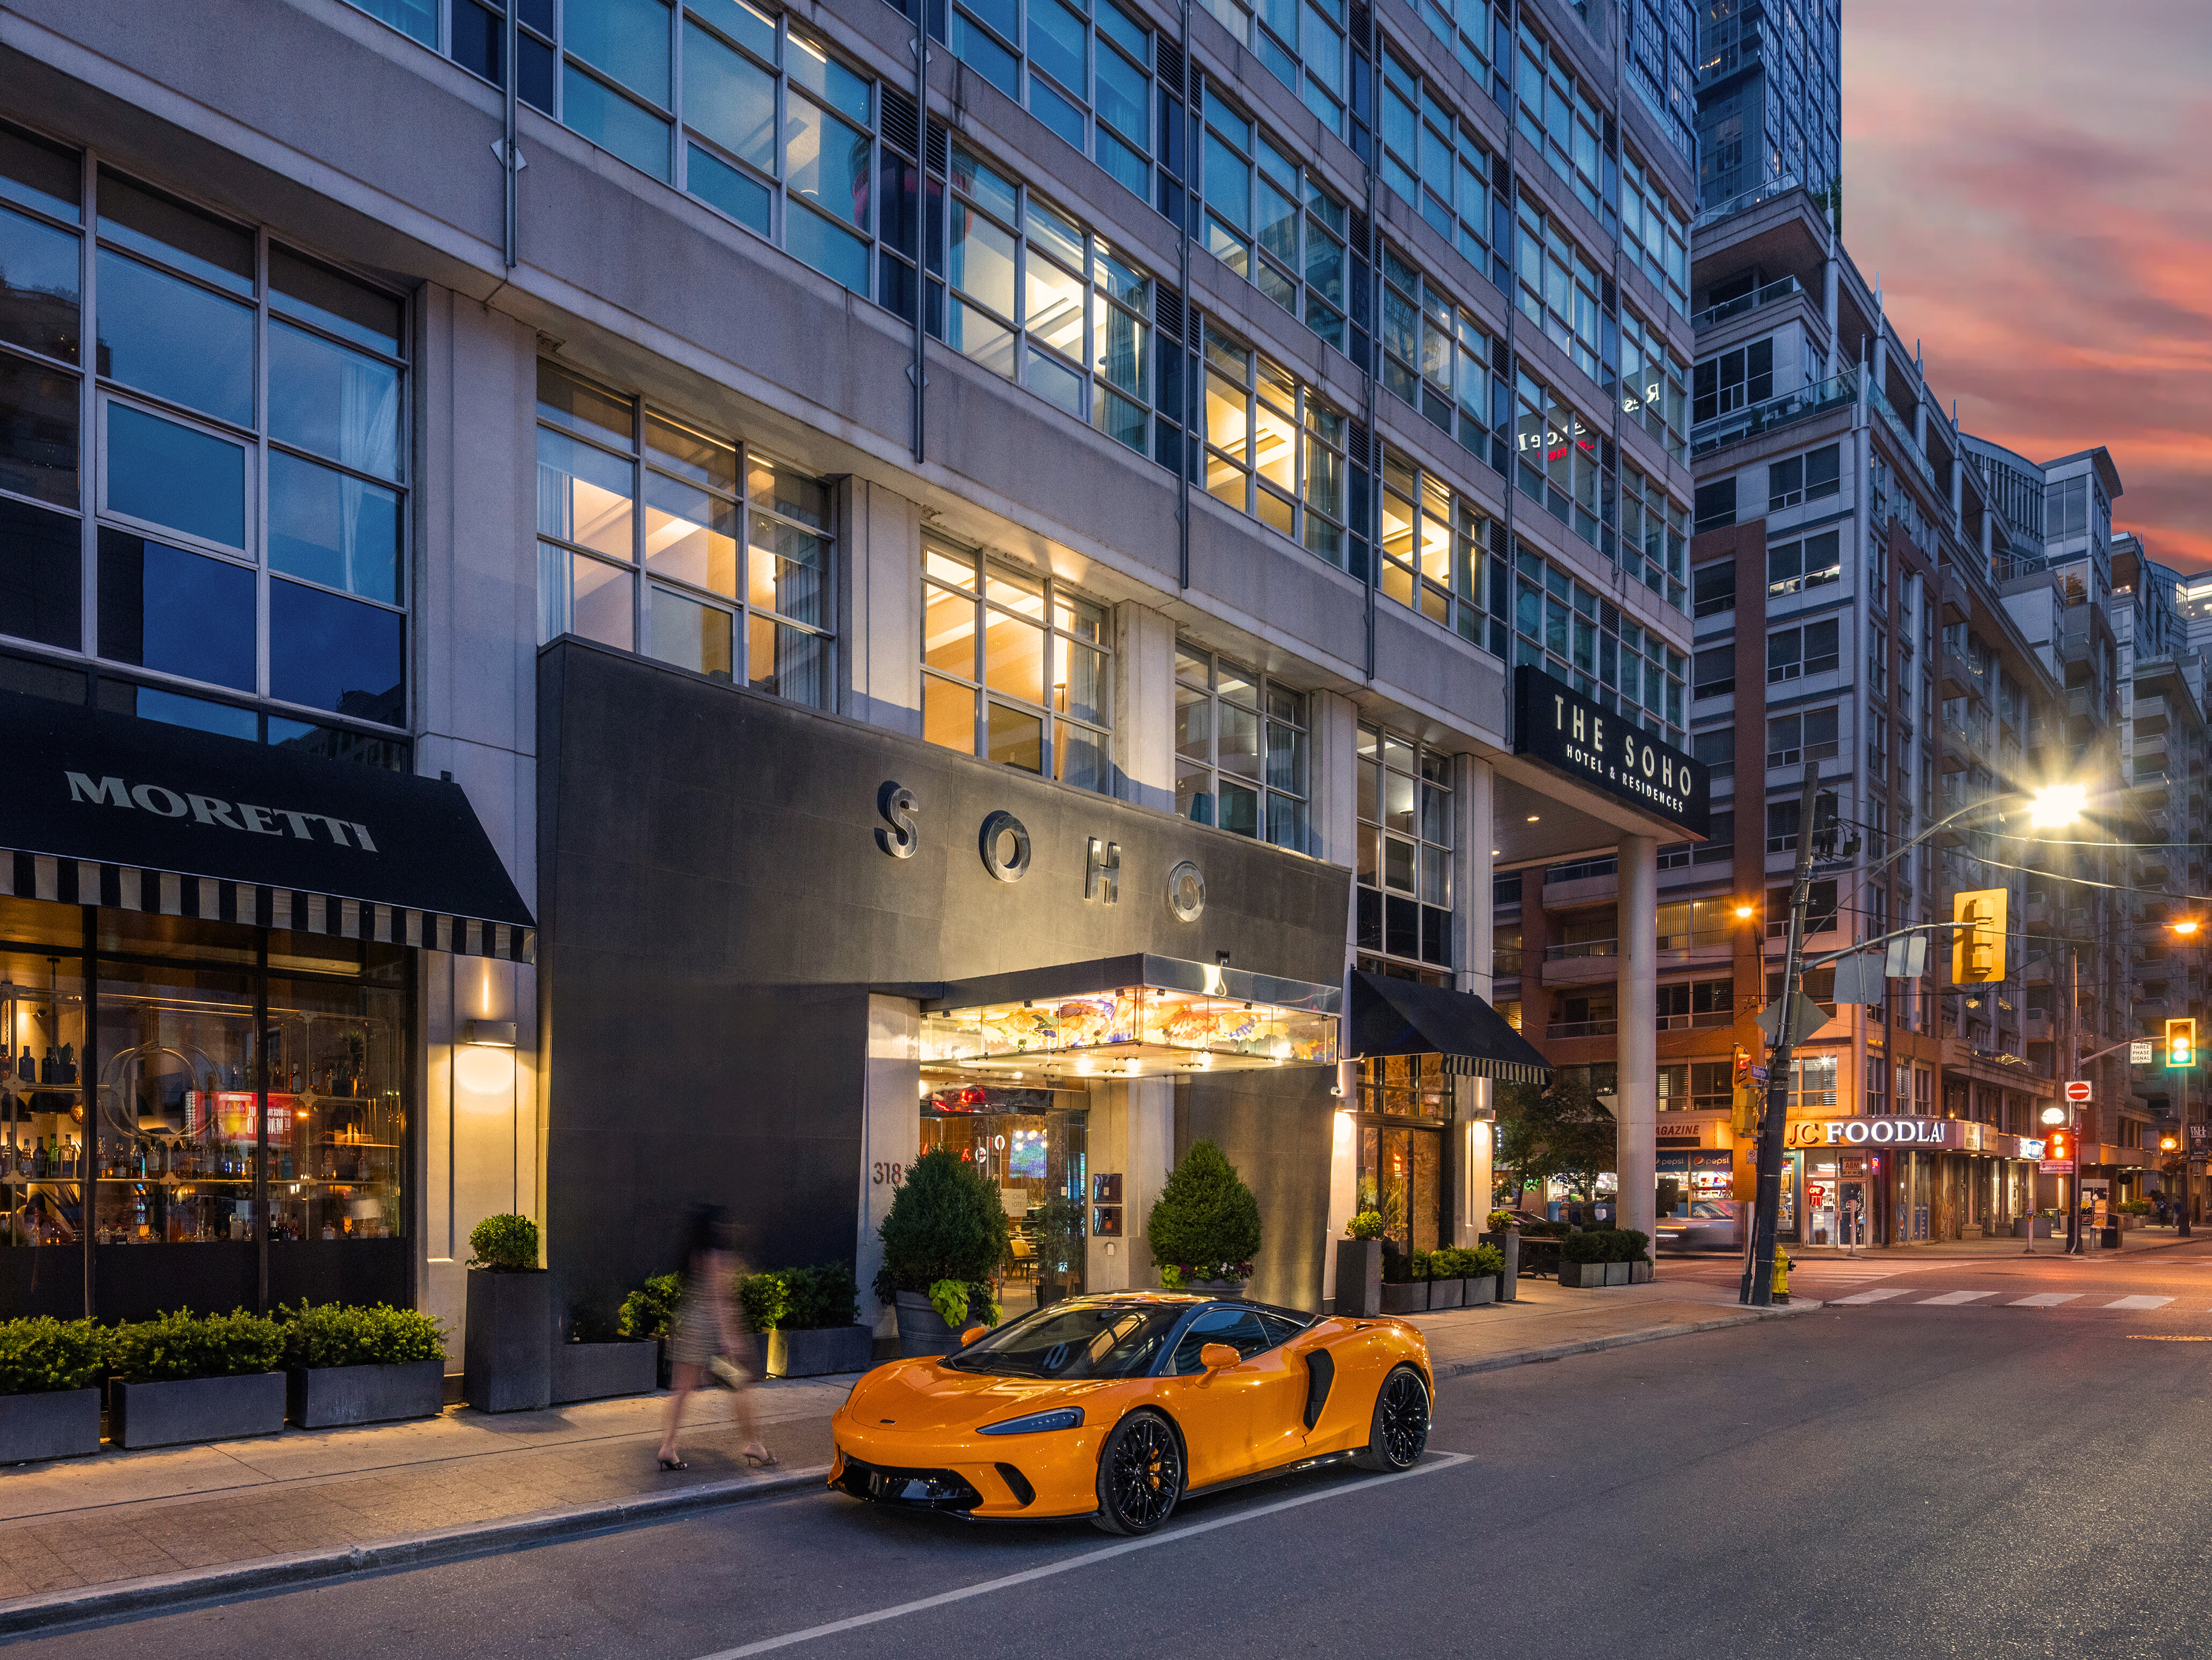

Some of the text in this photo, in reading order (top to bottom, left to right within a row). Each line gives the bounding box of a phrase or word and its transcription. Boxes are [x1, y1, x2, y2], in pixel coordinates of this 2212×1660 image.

[1555, 694, 1691, 796] THE SOHO
[1567, 744, 1683, 813] HOTEL & RESIDENCES
[64, 770, 379, 852] MORETTI
[884, 786, 1206, 922] SOHO
[1656, 1125, 1699, 1136] AGAZINE
[1787, 1123, 1819, 1143] JC
[873, 1161, 902, 1185] 318
[1662, 1158, 1684, 1166] pepsi
[1706, 1157, 1730, 1166] pepsi
